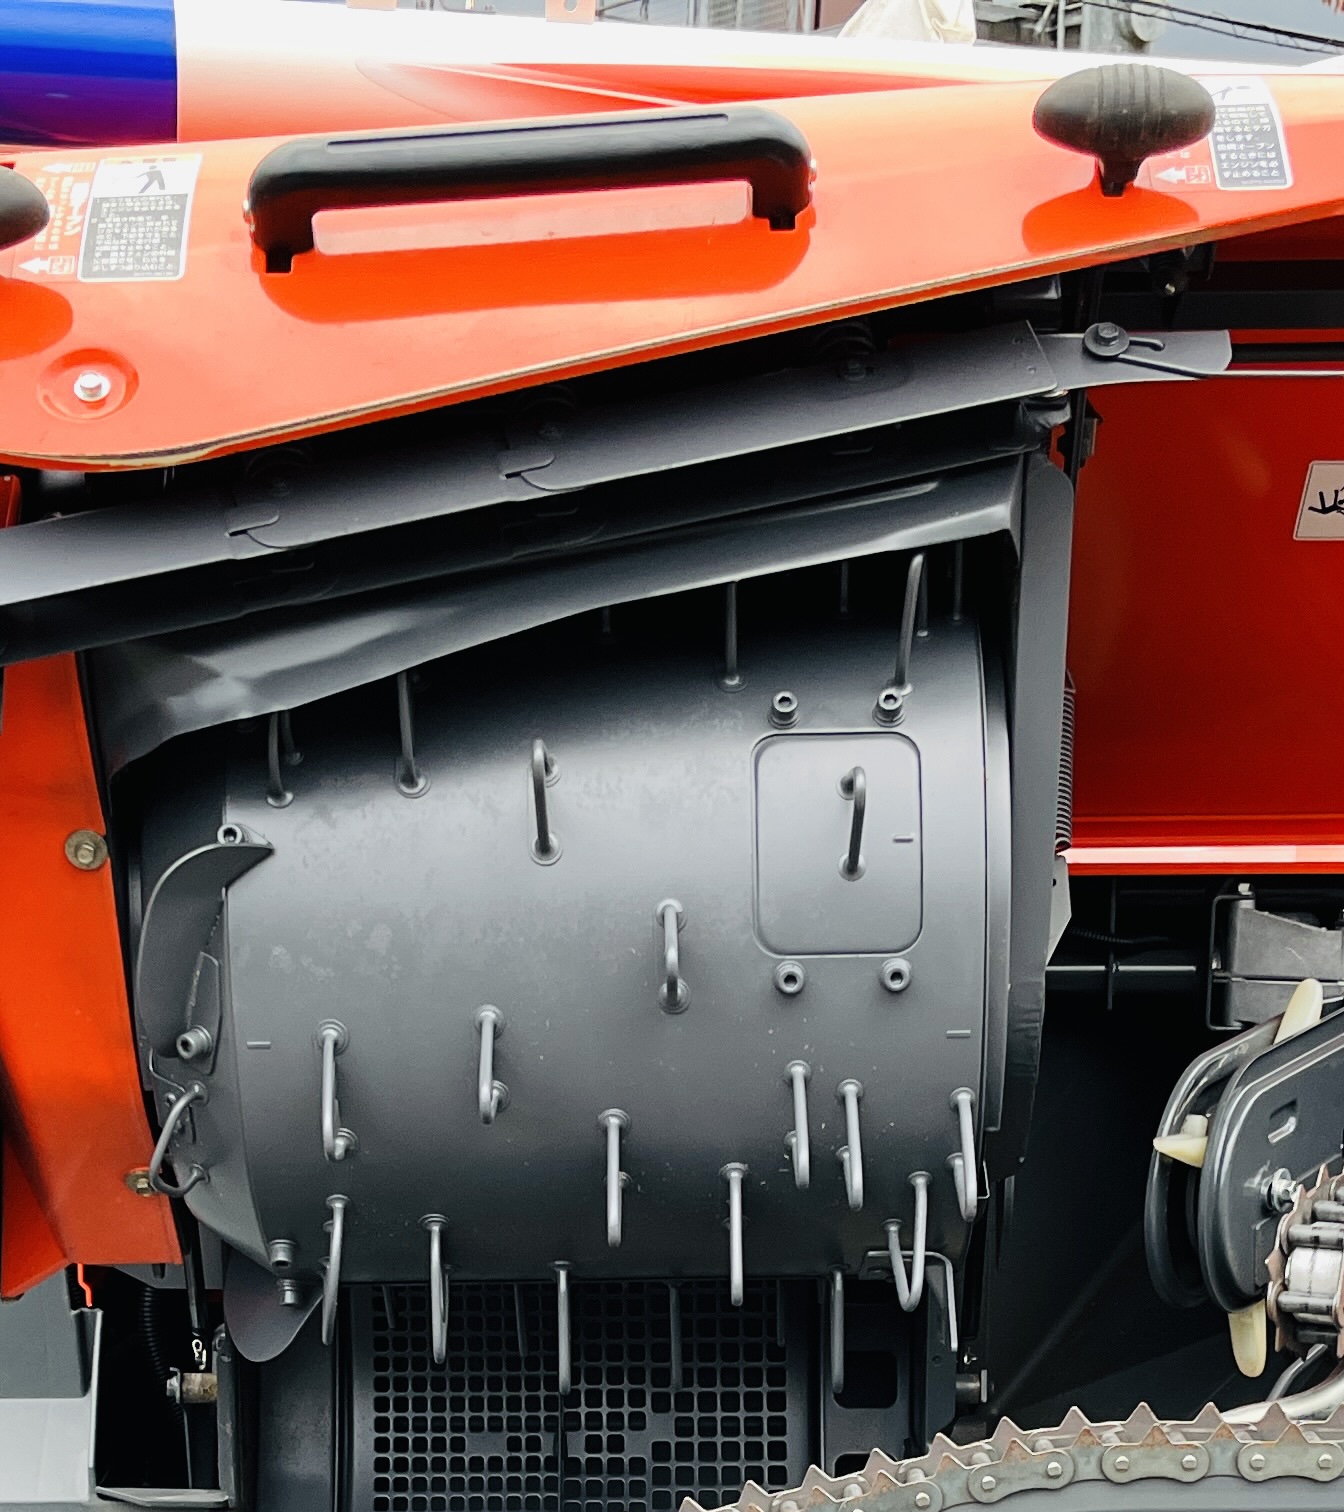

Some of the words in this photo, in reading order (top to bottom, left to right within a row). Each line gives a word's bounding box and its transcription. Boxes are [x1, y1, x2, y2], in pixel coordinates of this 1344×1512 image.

[1219, 152, 1277, 160] するときには
[1221, 161, 1279, 169] エンジンを必
[1224, 170, 1280, 179] ず止めること
